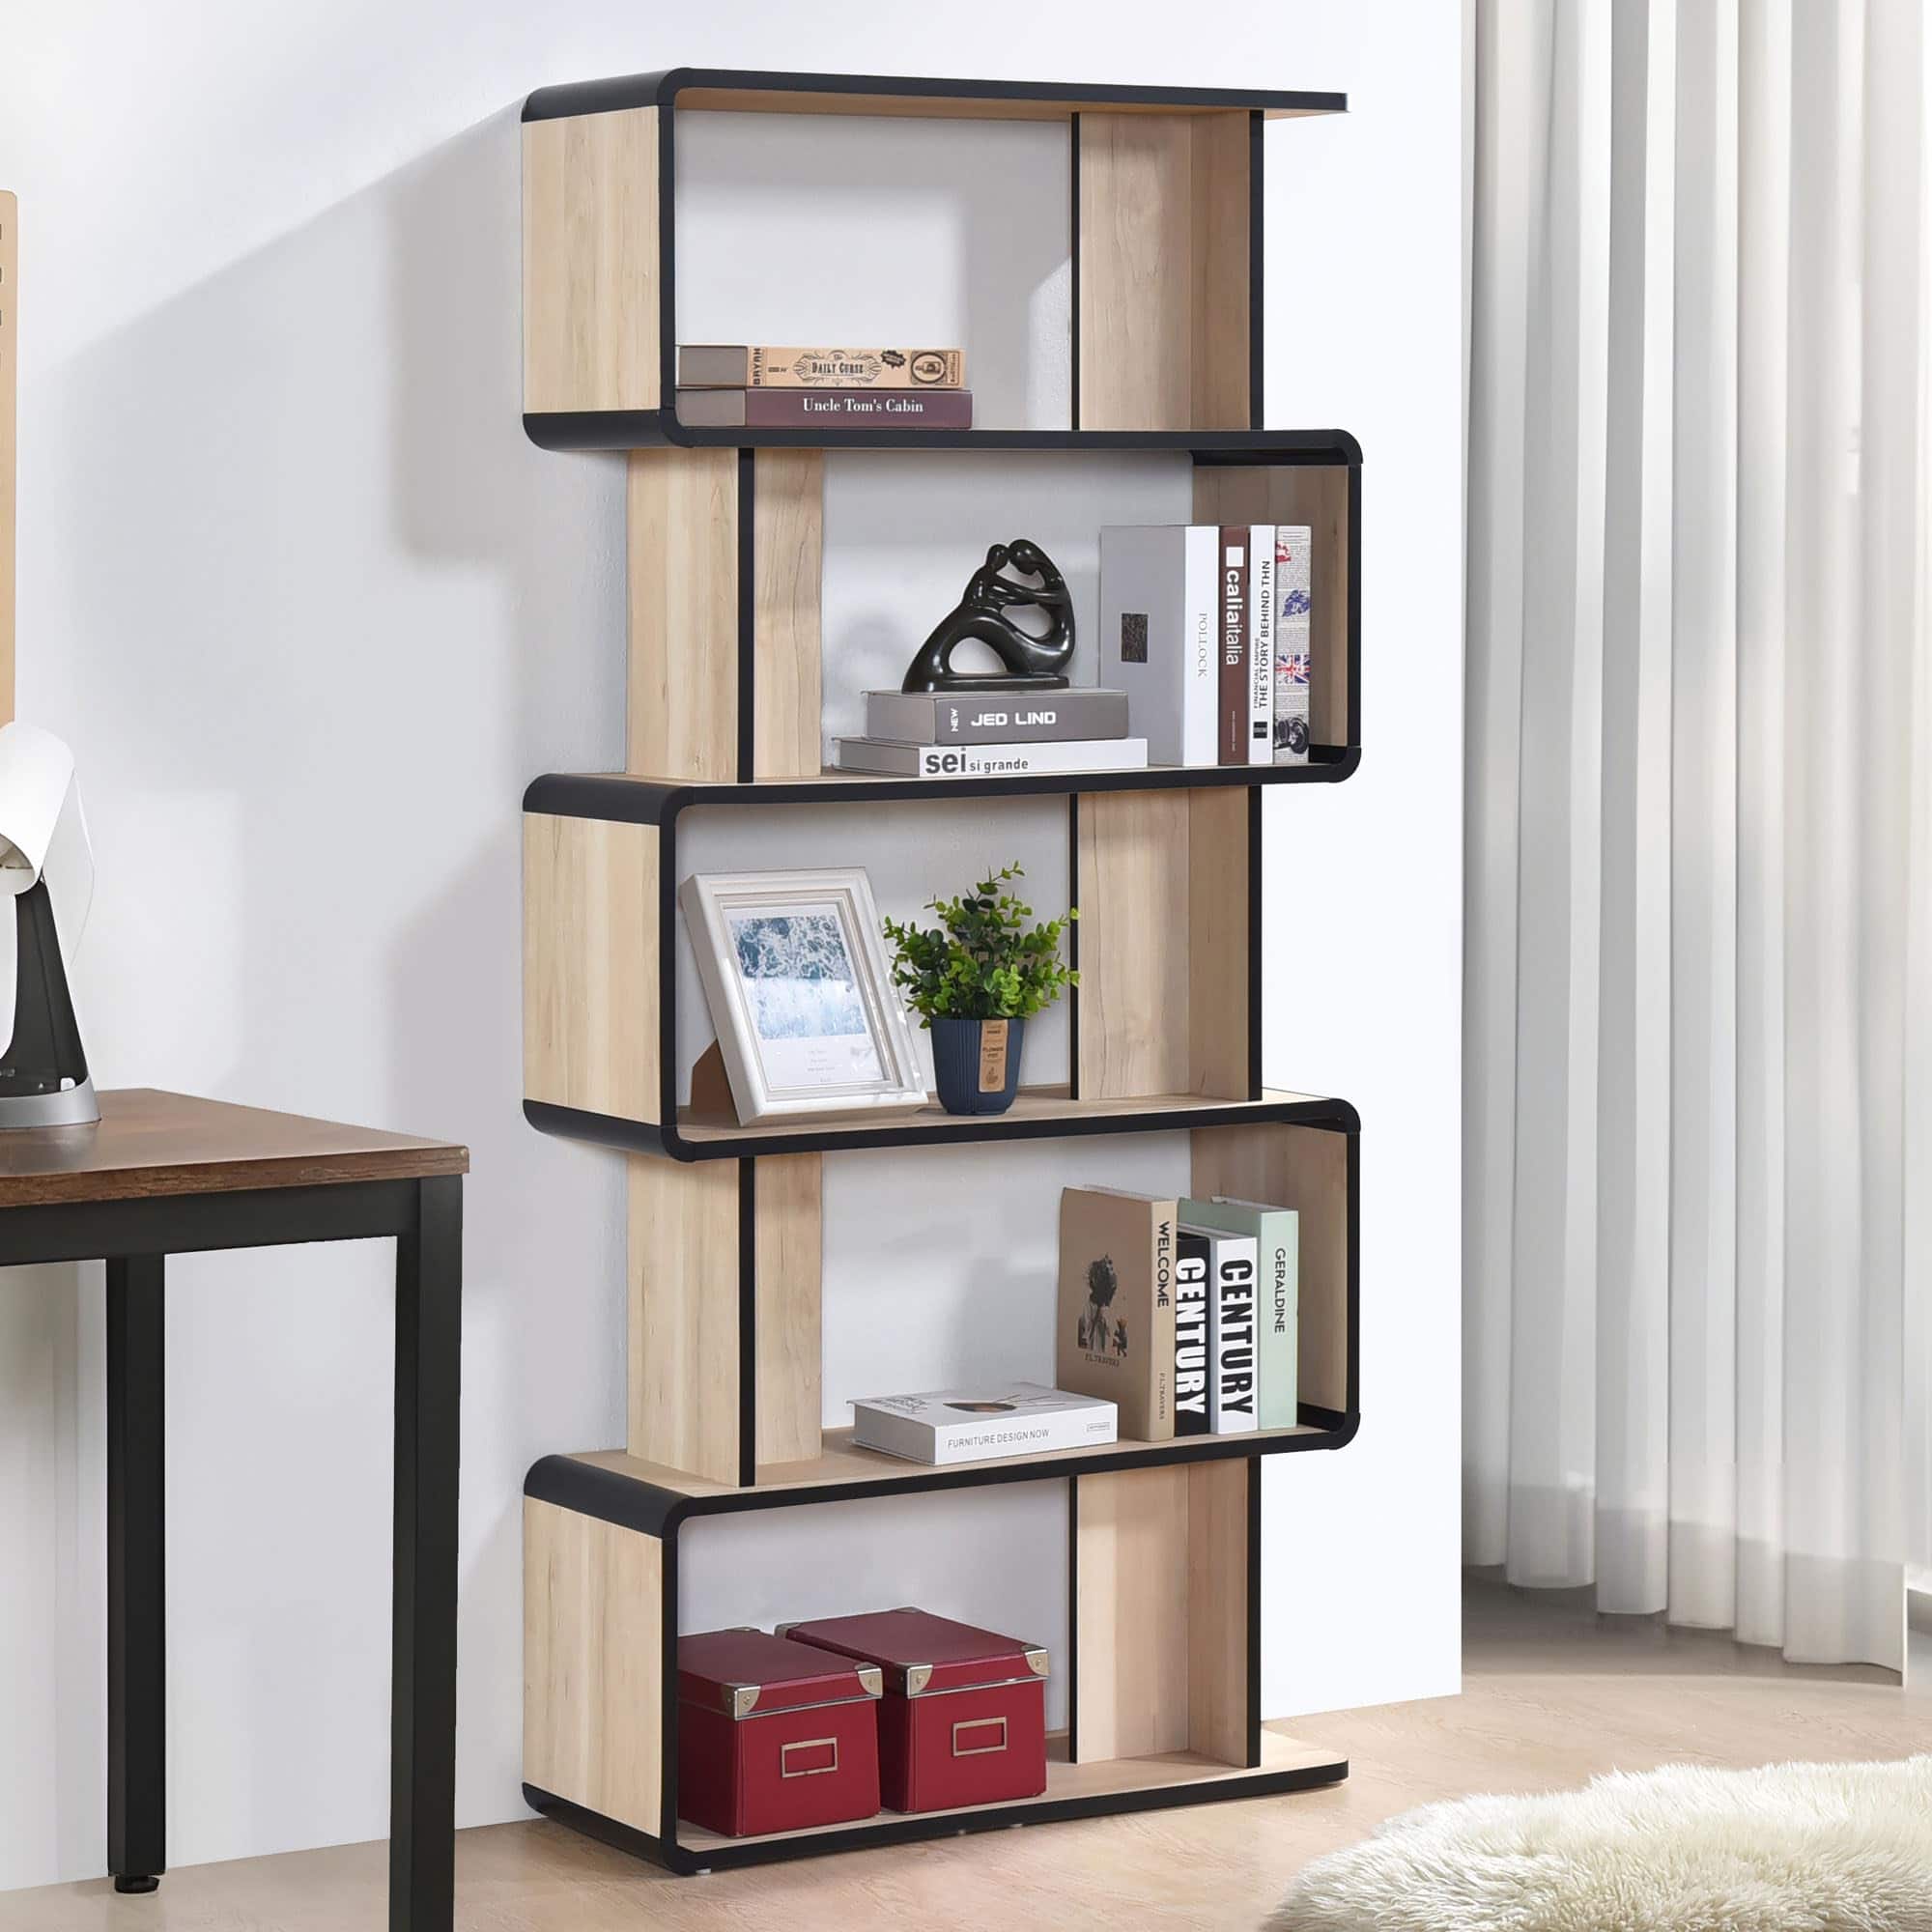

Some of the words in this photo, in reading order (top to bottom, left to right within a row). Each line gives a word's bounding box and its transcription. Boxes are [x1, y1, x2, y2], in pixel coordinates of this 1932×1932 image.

[803, 397, 841, 412] Uncle
[843, 397, 883, 412] Tom's
[885, 398, 923, 413] Cabin
[1261, 560, 1271, 587] THN
[1226, 570, 1243, 666] caliaitalia
[1260, 590, 1270, 638] BEHIND
[1198, 612, 1208, 678] POLLOCK
[1260, 640, 1268, 682] STORY
[971, 713, 1008, 726] JED
[1014, 711, 1057, 725] LIND
[1259, 687, 1268, 709] THE
[951, 708, 959, 732] NEW
[924, 747, 966, 774] sei
[969, 759, 980, 772] si
[983, 758, 1029, 774] grande
[1157, 1221, 1170, 1308] WELCOME
[1274, 1247, 1287, 1334] GERALDINE
[1176, 1257, 1206, 1414] CENTURY
[1220, 1260, 1253, 1414] CENTURY
[948, 1435, 995, 1449] FURNITURE
[996, 1431, 1030, 1444] DESIGN
[1029, 1429, 1050, 1438] NOW
